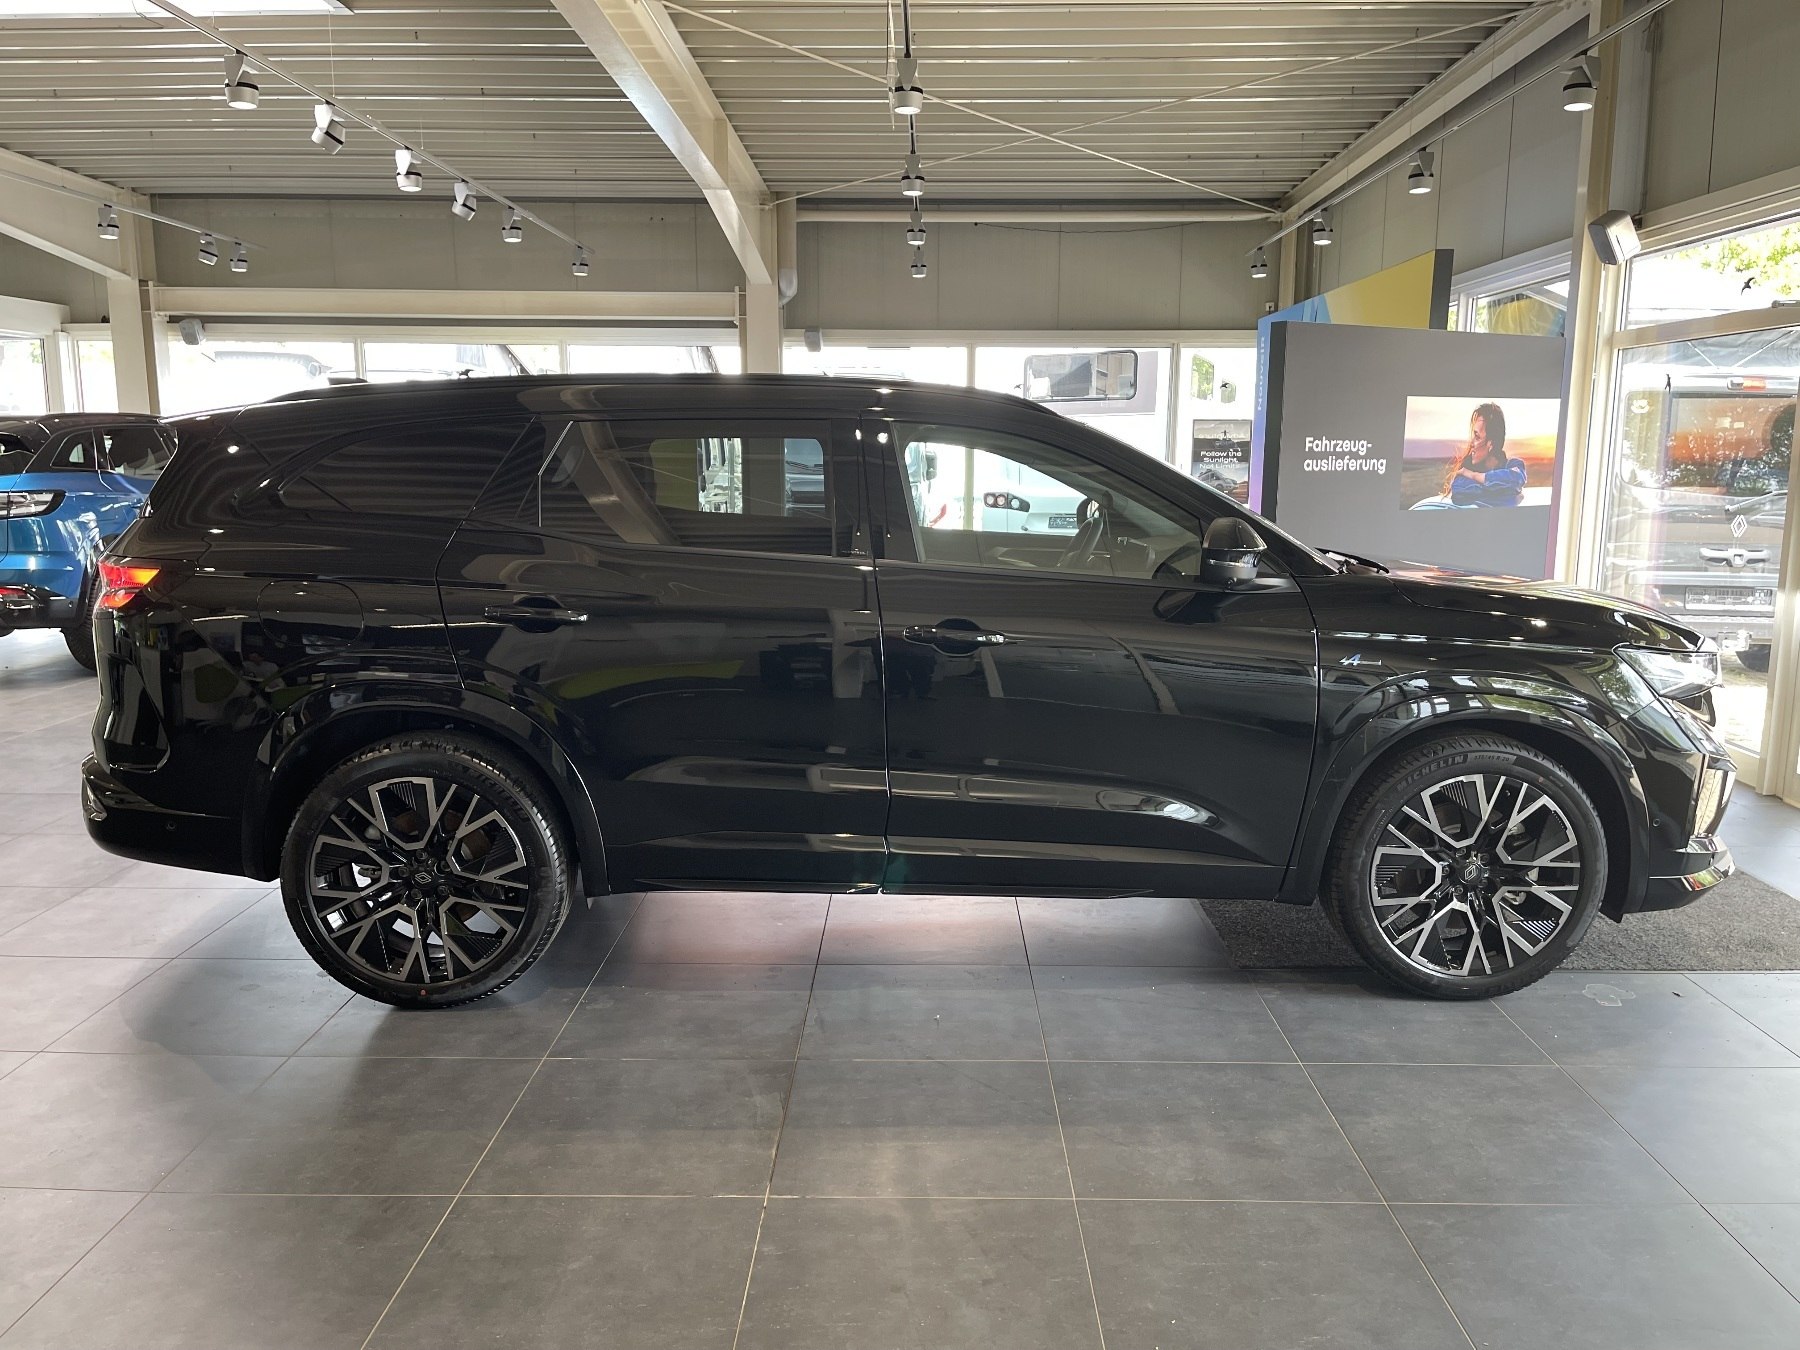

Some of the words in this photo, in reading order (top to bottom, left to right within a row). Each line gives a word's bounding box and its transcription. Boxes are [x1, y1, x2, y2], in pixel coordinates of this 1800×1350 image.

[1228, 448, 1242, 457] the
[1305, 436, 1372, 456] Fahrzeug-
[1303, 455, 1386, 475] auslieferung
[1396, 754, 1465, 791] MICHELIN
